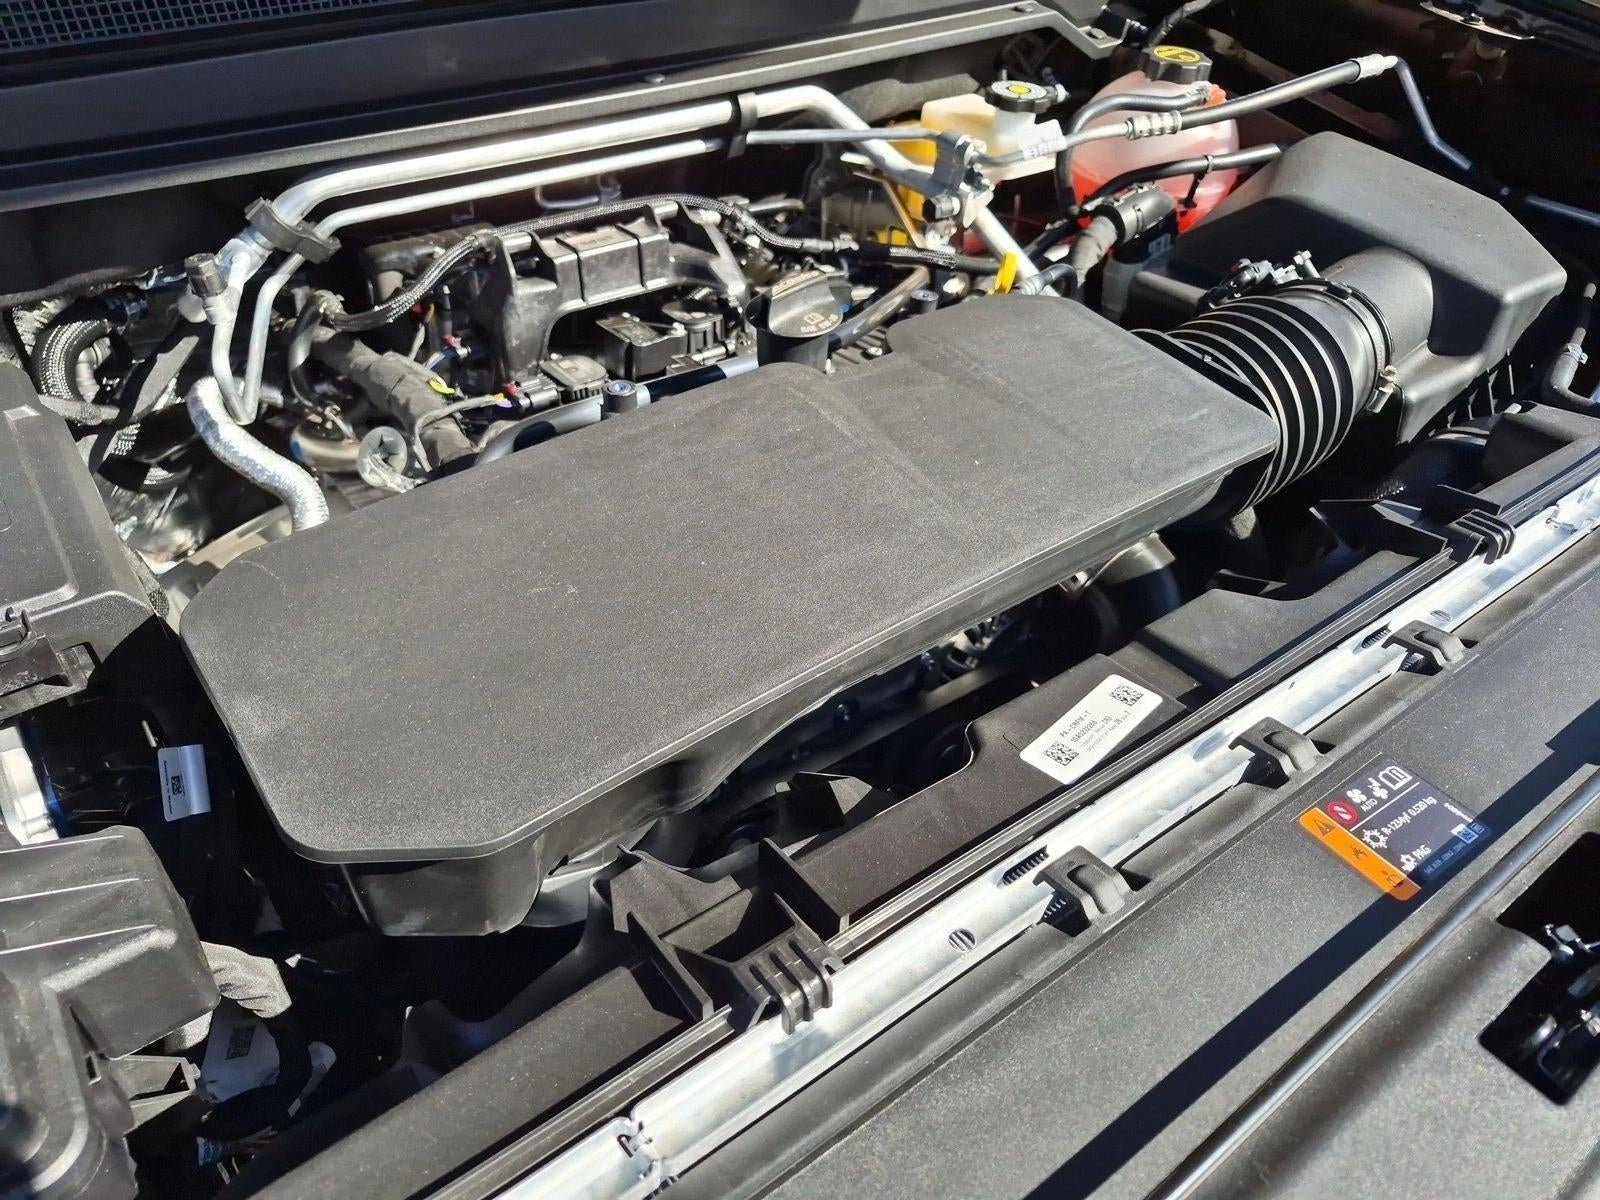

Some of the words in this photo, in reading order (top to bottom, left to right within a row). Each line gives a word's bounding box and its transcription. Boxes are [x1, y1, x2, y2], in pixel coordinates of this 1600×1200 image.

[1360, 798, 1378, 812] AUTO
[1381, 811, 1412, 836] R-1234yf
[1422, 796, 1438, 806] kg
[1411, 844, 1432, 860] PAG
